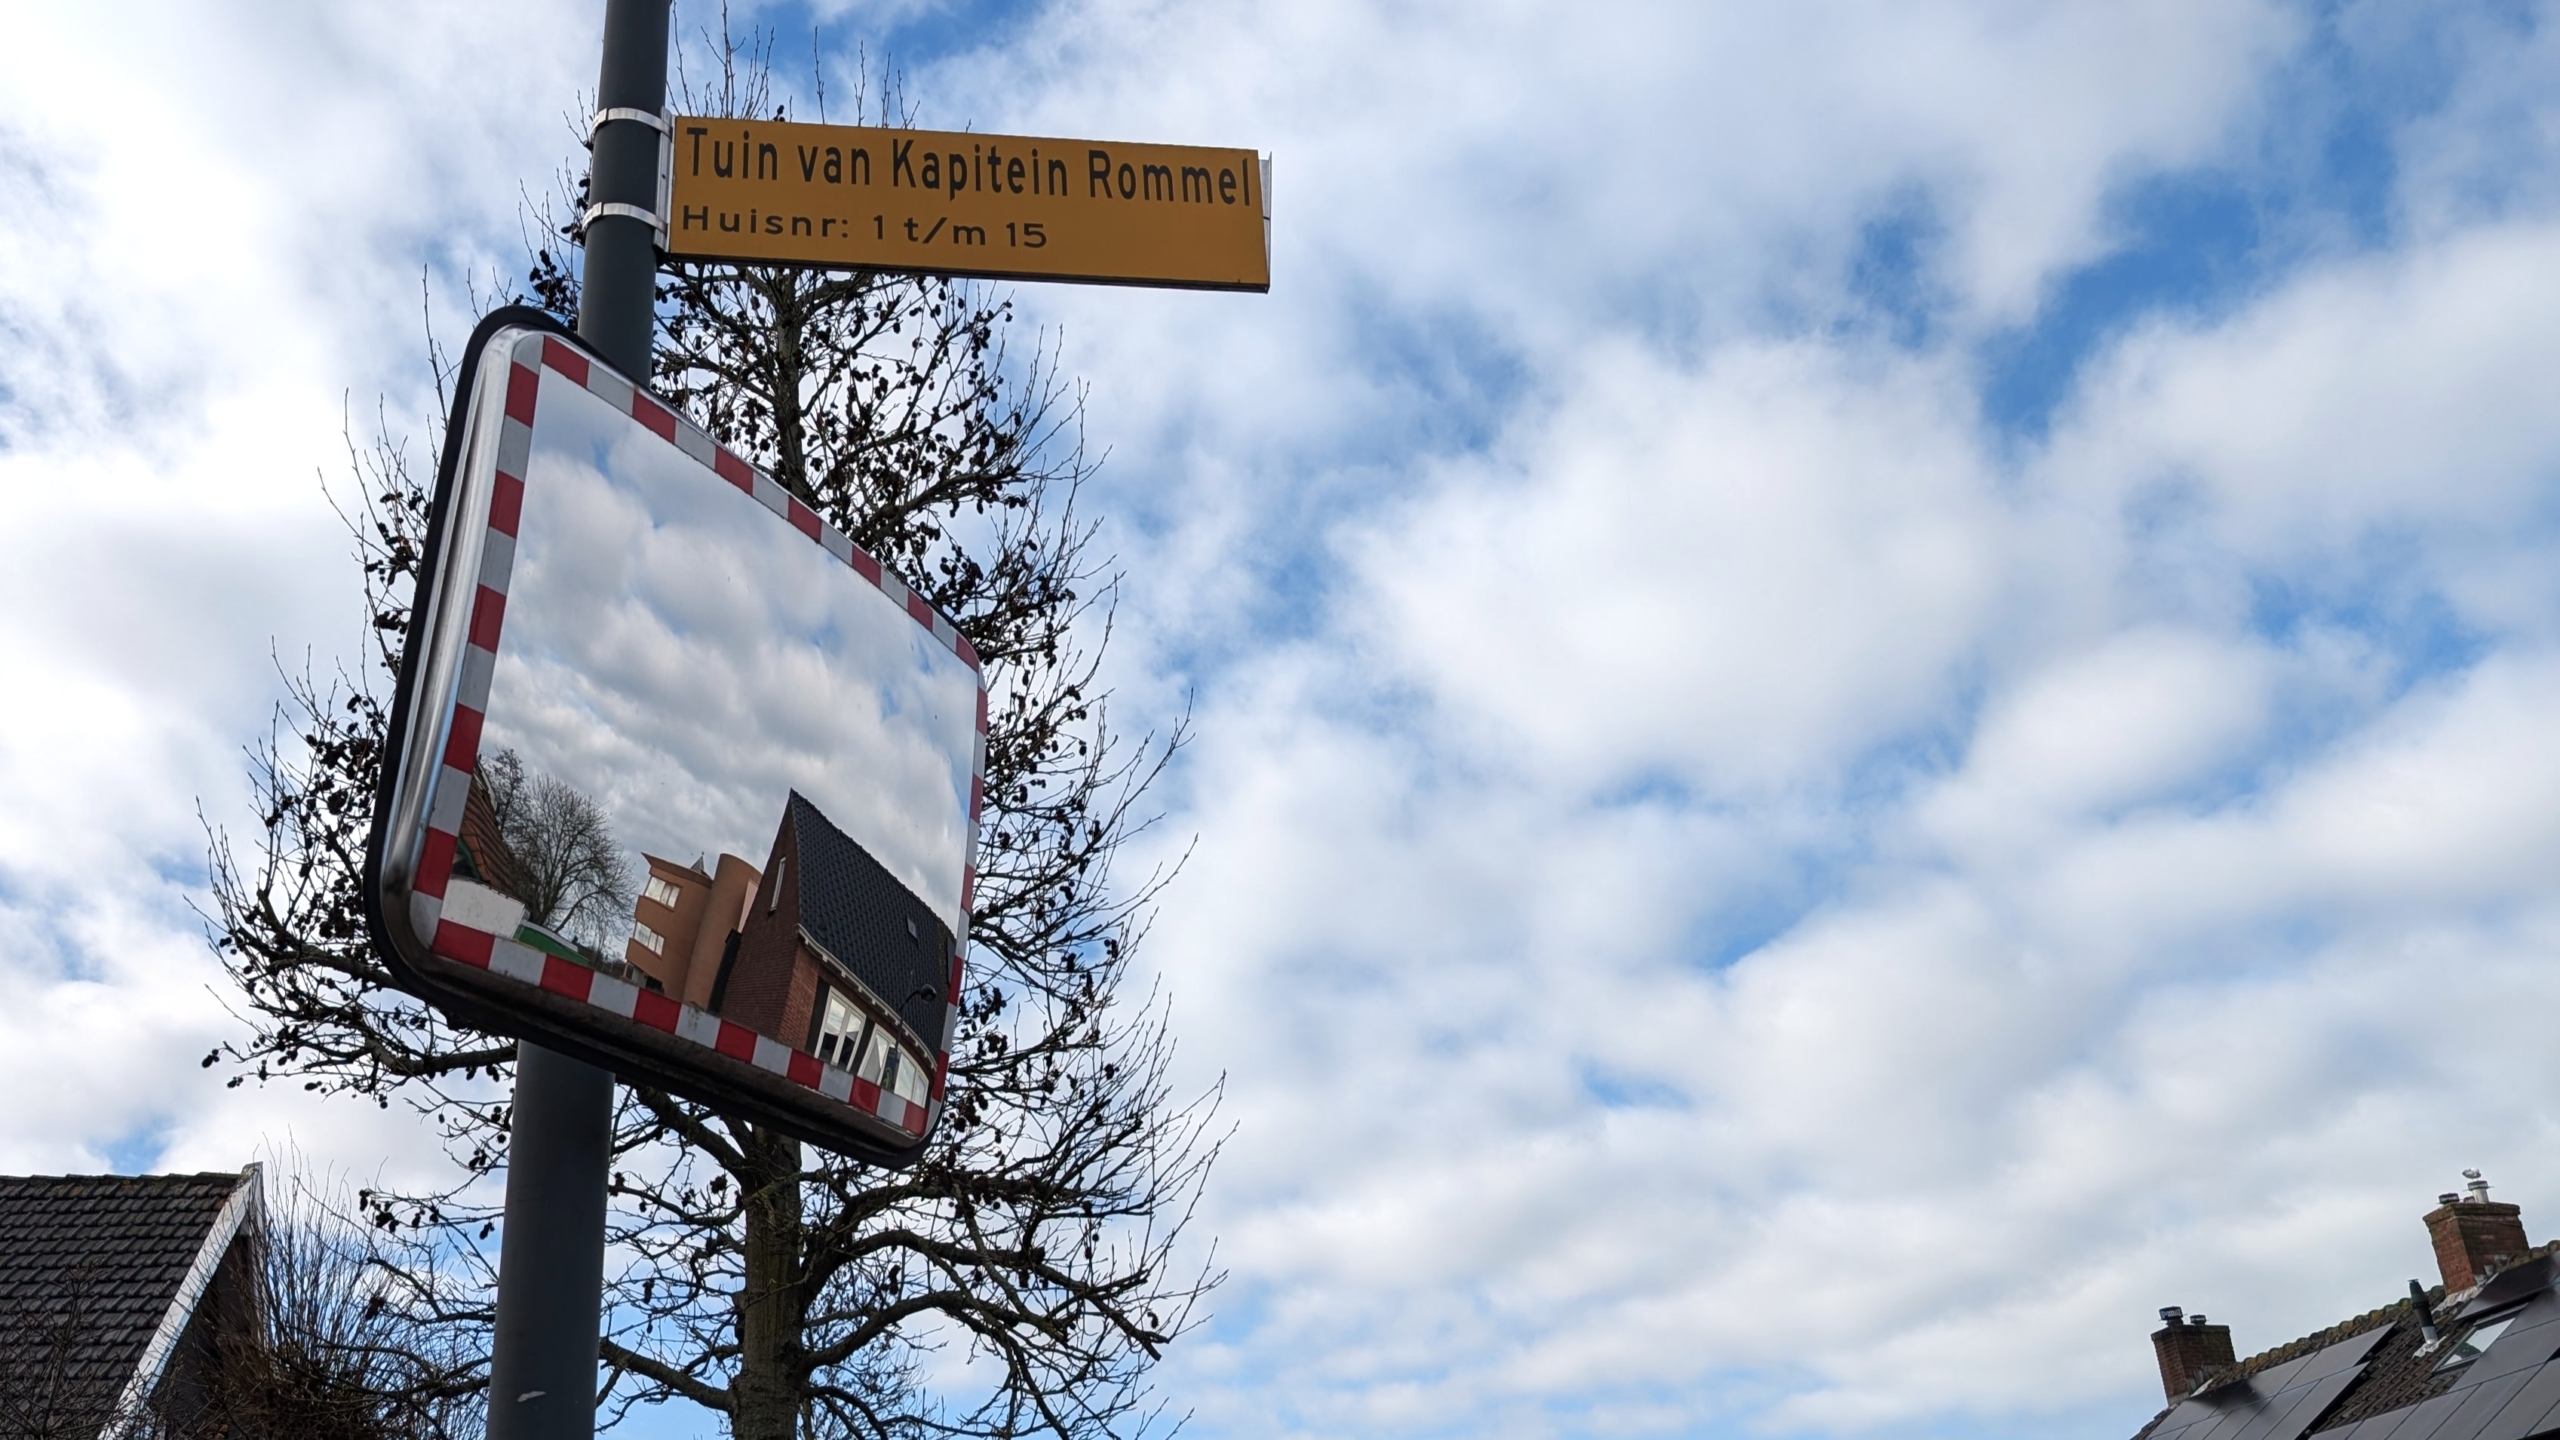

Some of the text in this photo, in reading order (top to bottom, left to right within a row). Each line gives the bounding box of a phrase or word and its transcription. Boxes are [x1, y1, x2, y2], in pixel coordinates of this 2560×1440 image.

[686, 126, 1250, 207] Tuin van Kapitein Rommel
[682, 204, 1048, 249] Huisnr: 1 t/m 15
